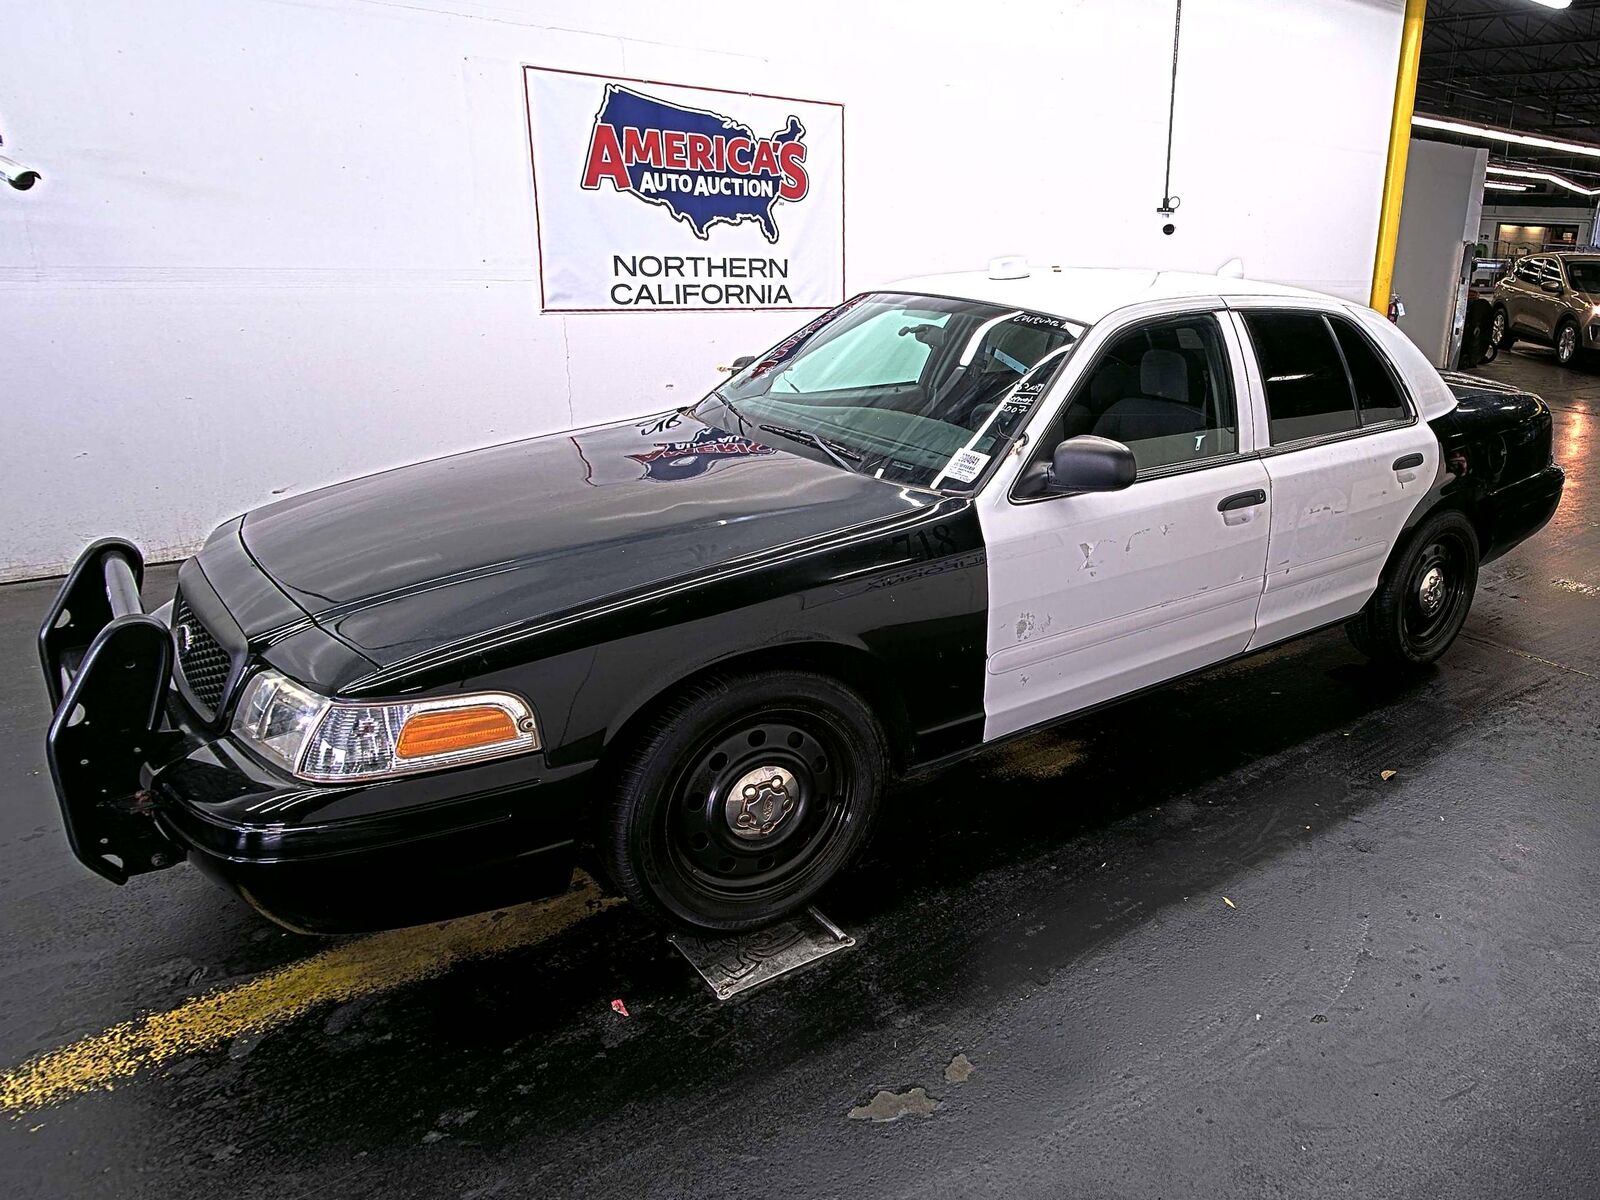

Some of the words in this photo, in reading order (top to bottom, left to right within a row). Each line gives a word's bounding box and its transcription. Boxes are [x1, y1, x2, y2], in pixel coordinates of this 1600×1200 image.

[583, 124, 807, 200] AMERICA'S
[640, 172, 690, 193] AUTO
[694, 175, 774, 198] AUCTION
[613, 256, 788, 278] NORTHERN
[610, 284, 793, 306] CALIFORNIA
[892, 525, 956, 560] 718
